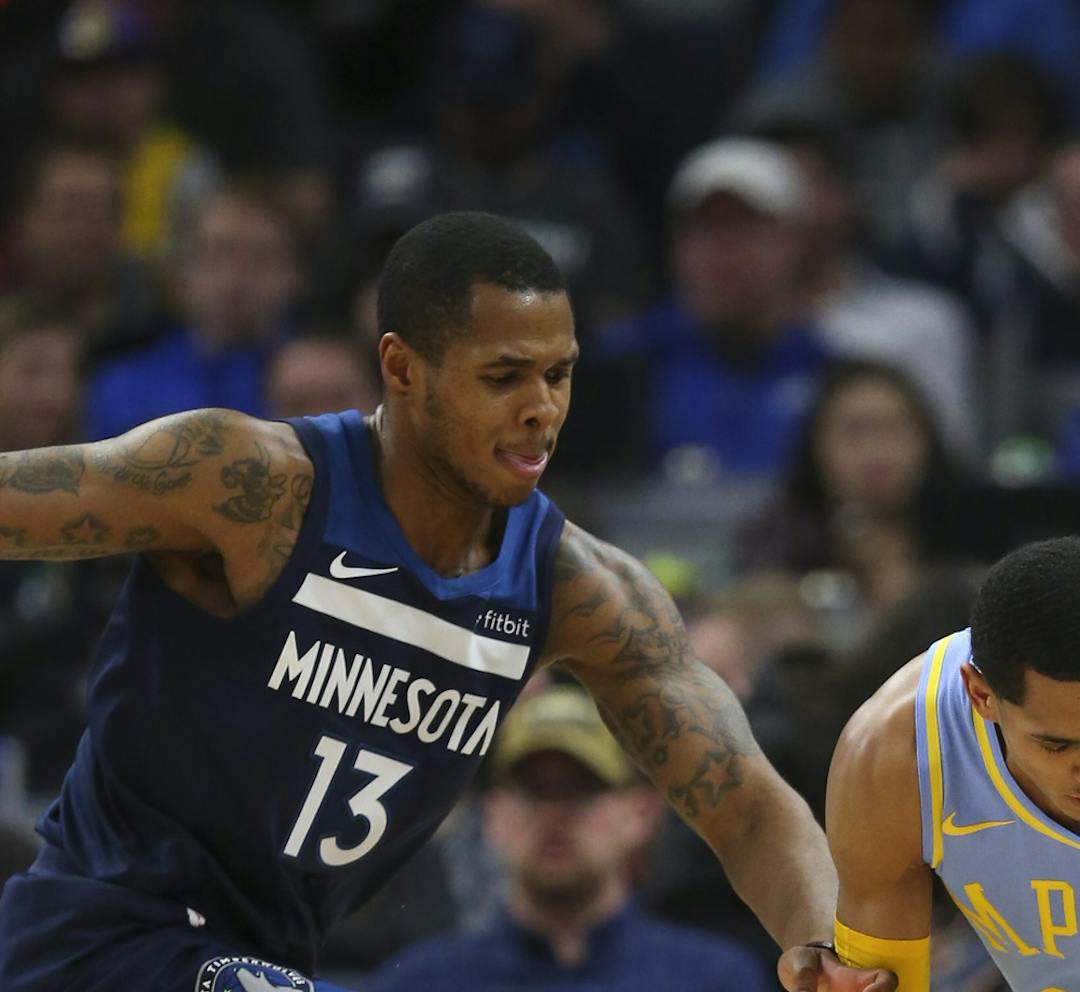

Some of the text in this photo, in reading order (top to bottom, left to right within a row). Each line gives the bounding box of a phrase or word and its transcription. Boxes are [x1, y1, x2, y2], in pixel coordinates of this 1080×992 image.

[483, 609, 530, 637] fitbit
[267, 630, 500, 757] MINNESOTA
[283, 735, 414, 867] 13
